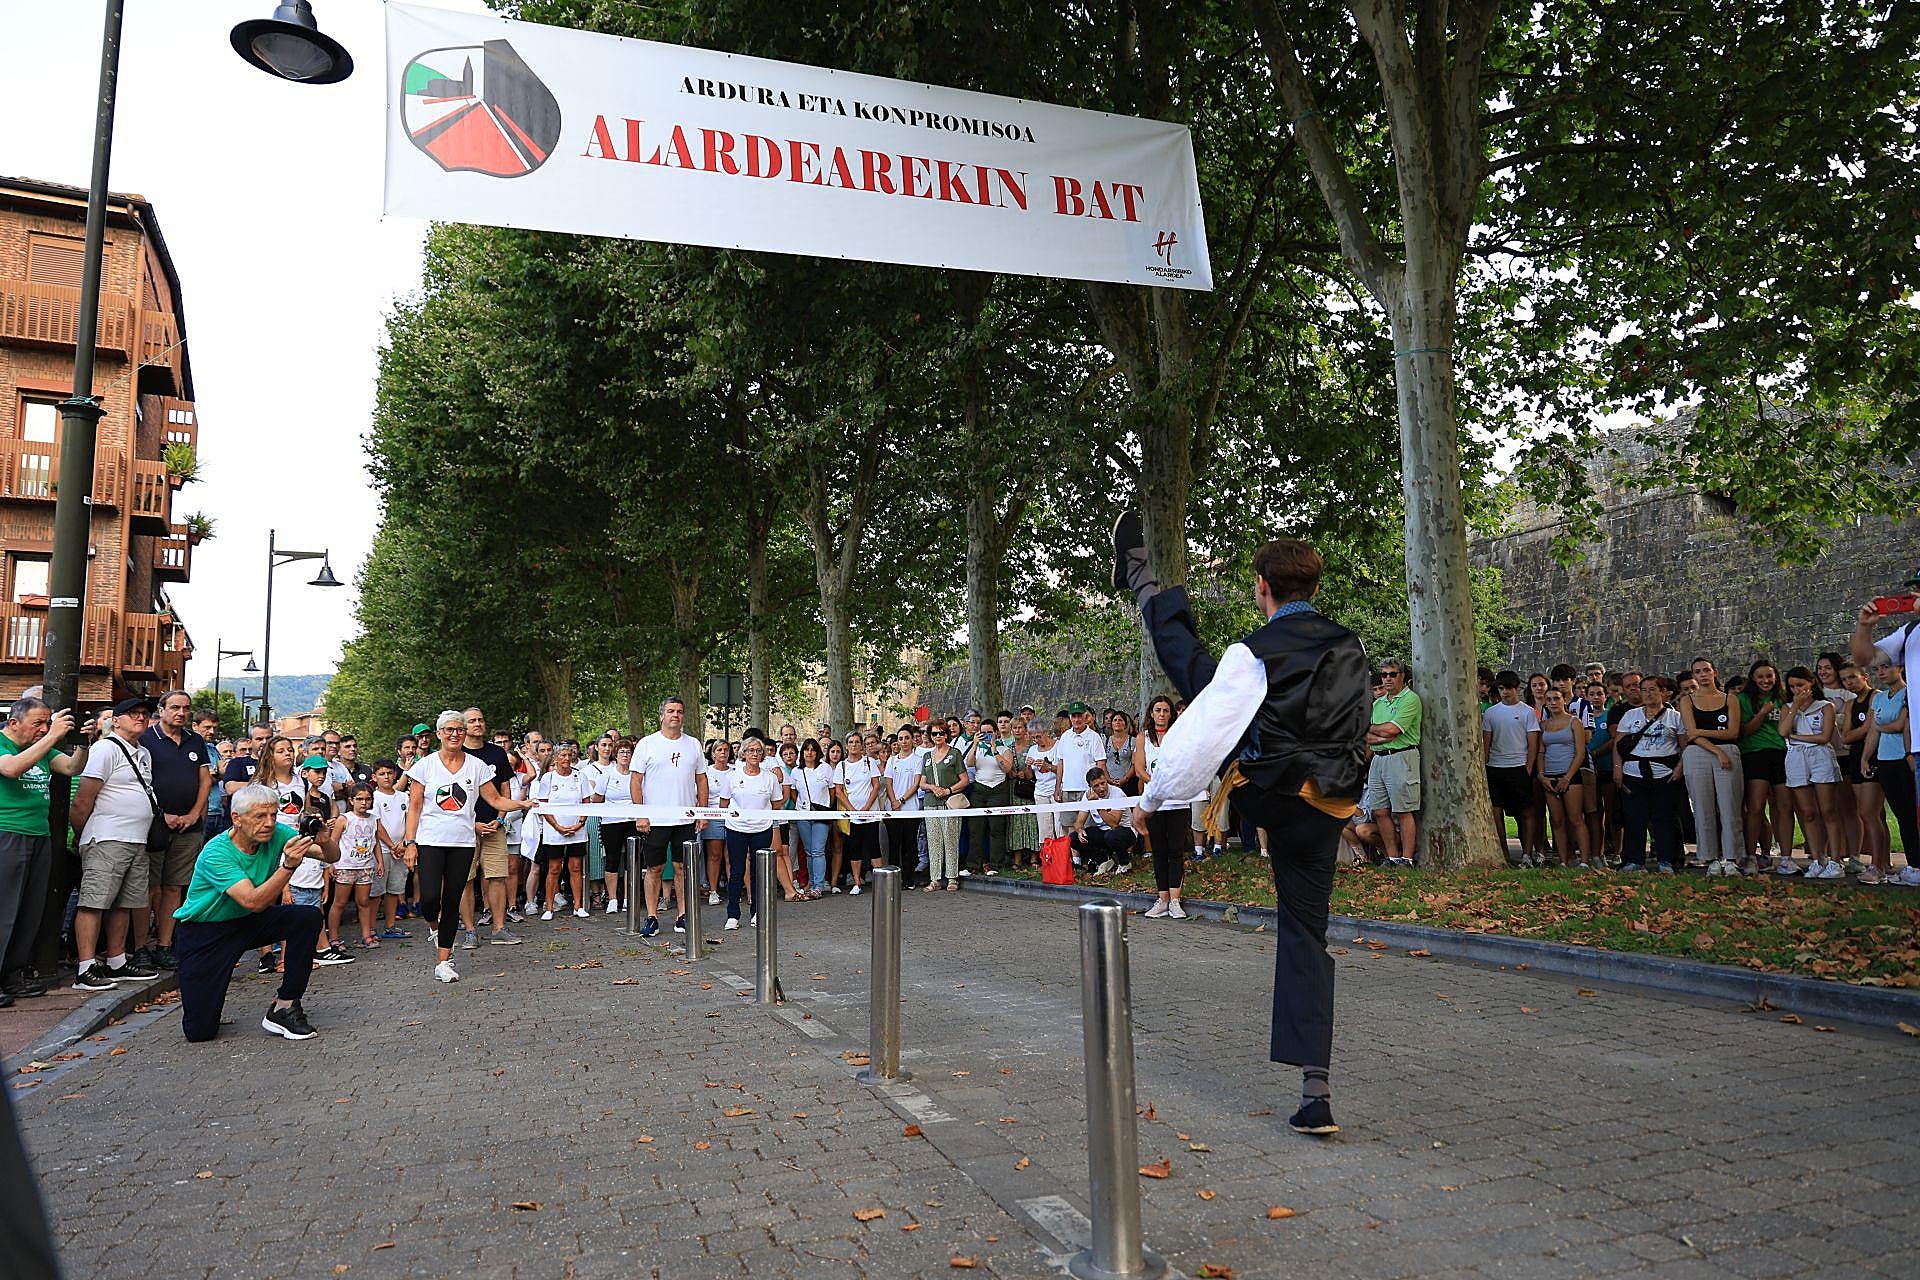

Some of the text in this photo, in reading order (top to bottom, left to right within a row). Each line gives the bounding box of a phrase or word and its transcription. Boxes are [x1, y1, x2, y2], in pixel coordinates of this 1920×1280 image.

[680, 76, 1037, 144] ARDURA ETA KONPROMISOA
[579, 114, 1145, 223] ALARDEAREKIN BAT
